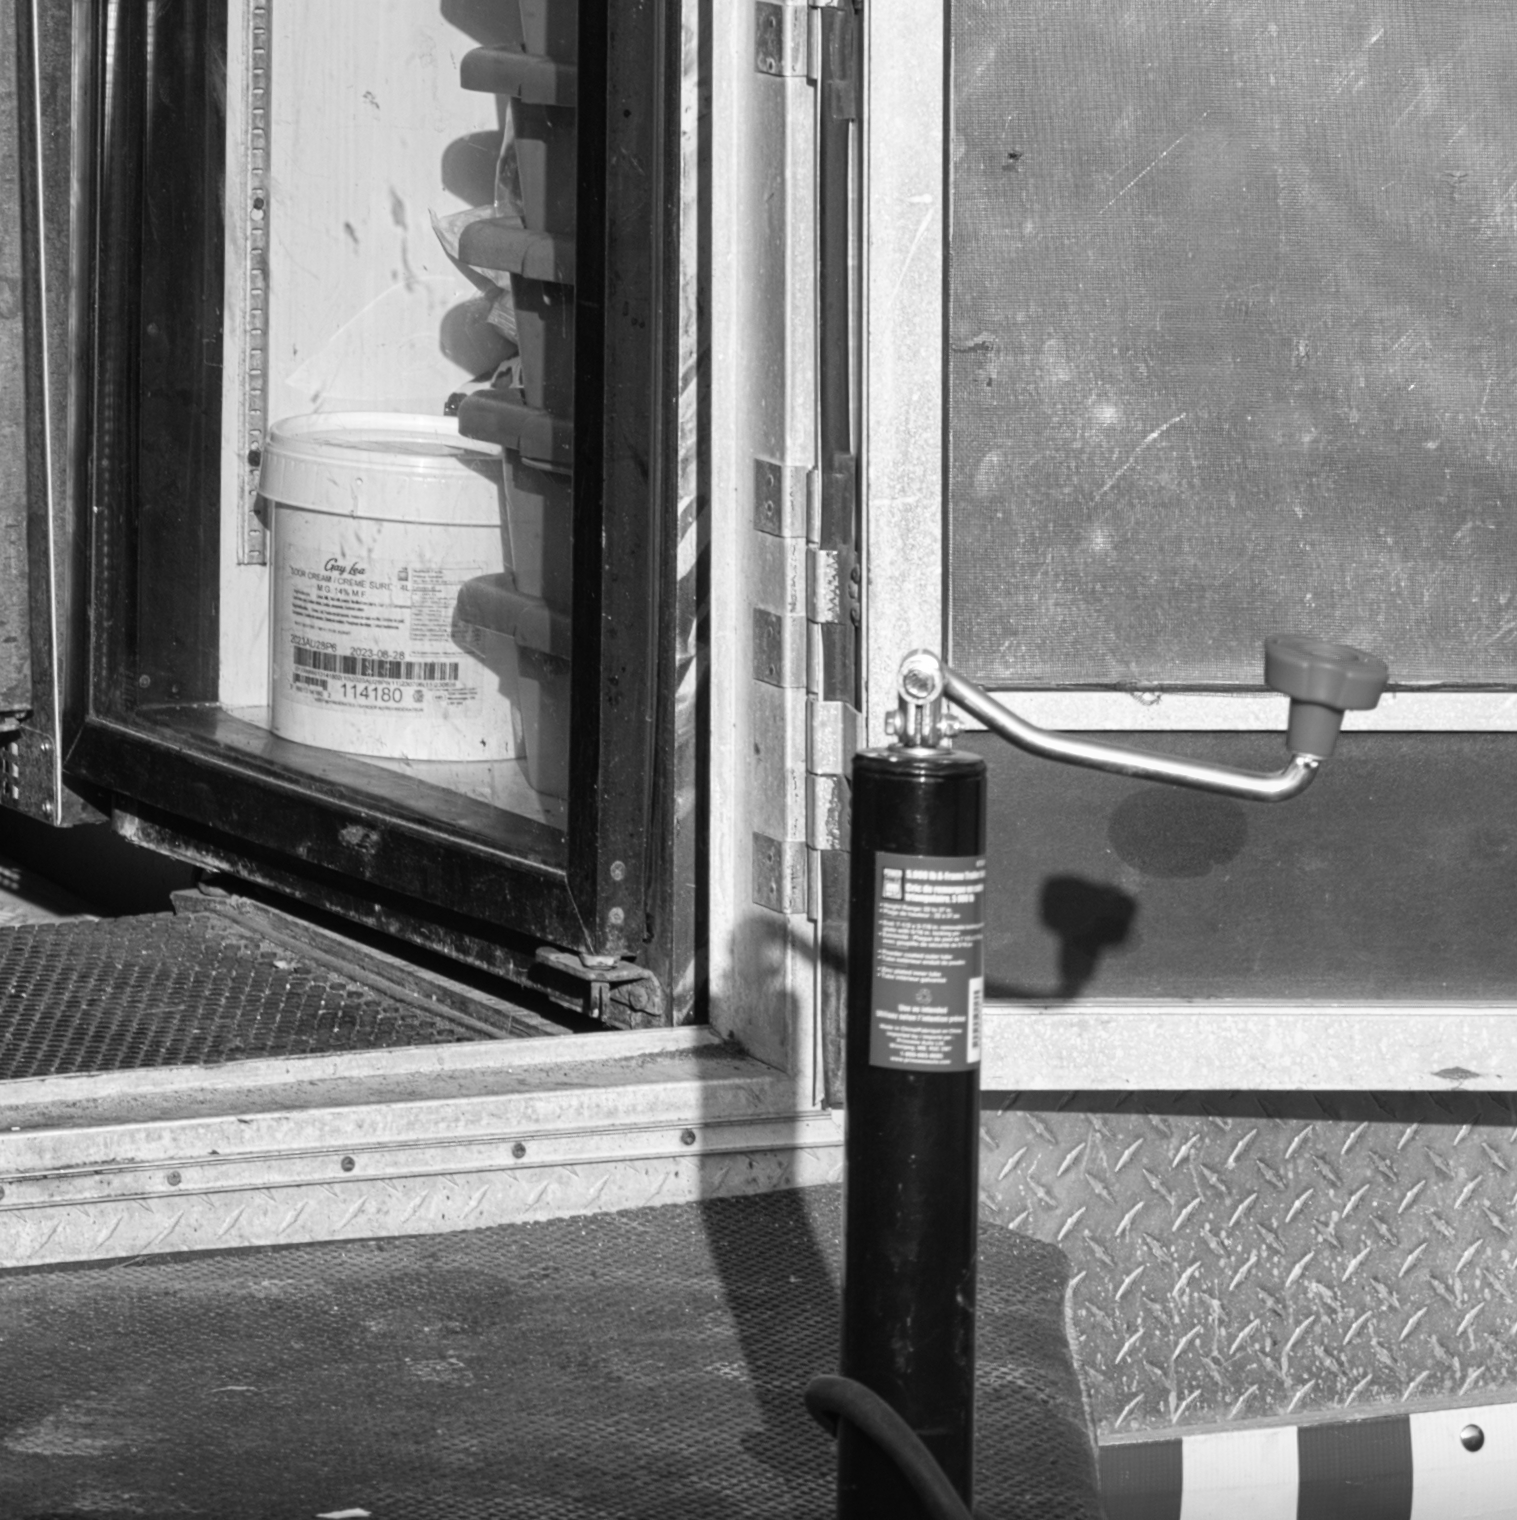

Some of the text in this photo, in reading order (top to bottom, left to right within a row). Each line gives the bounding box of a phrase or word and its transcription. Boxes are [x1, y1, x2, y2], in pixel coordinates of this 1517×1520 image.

[324, 557, 366, 576] Gay Lea
[350, 646, 405, 660] 2023-08-28
[340, 682, 403, 703] 114180
